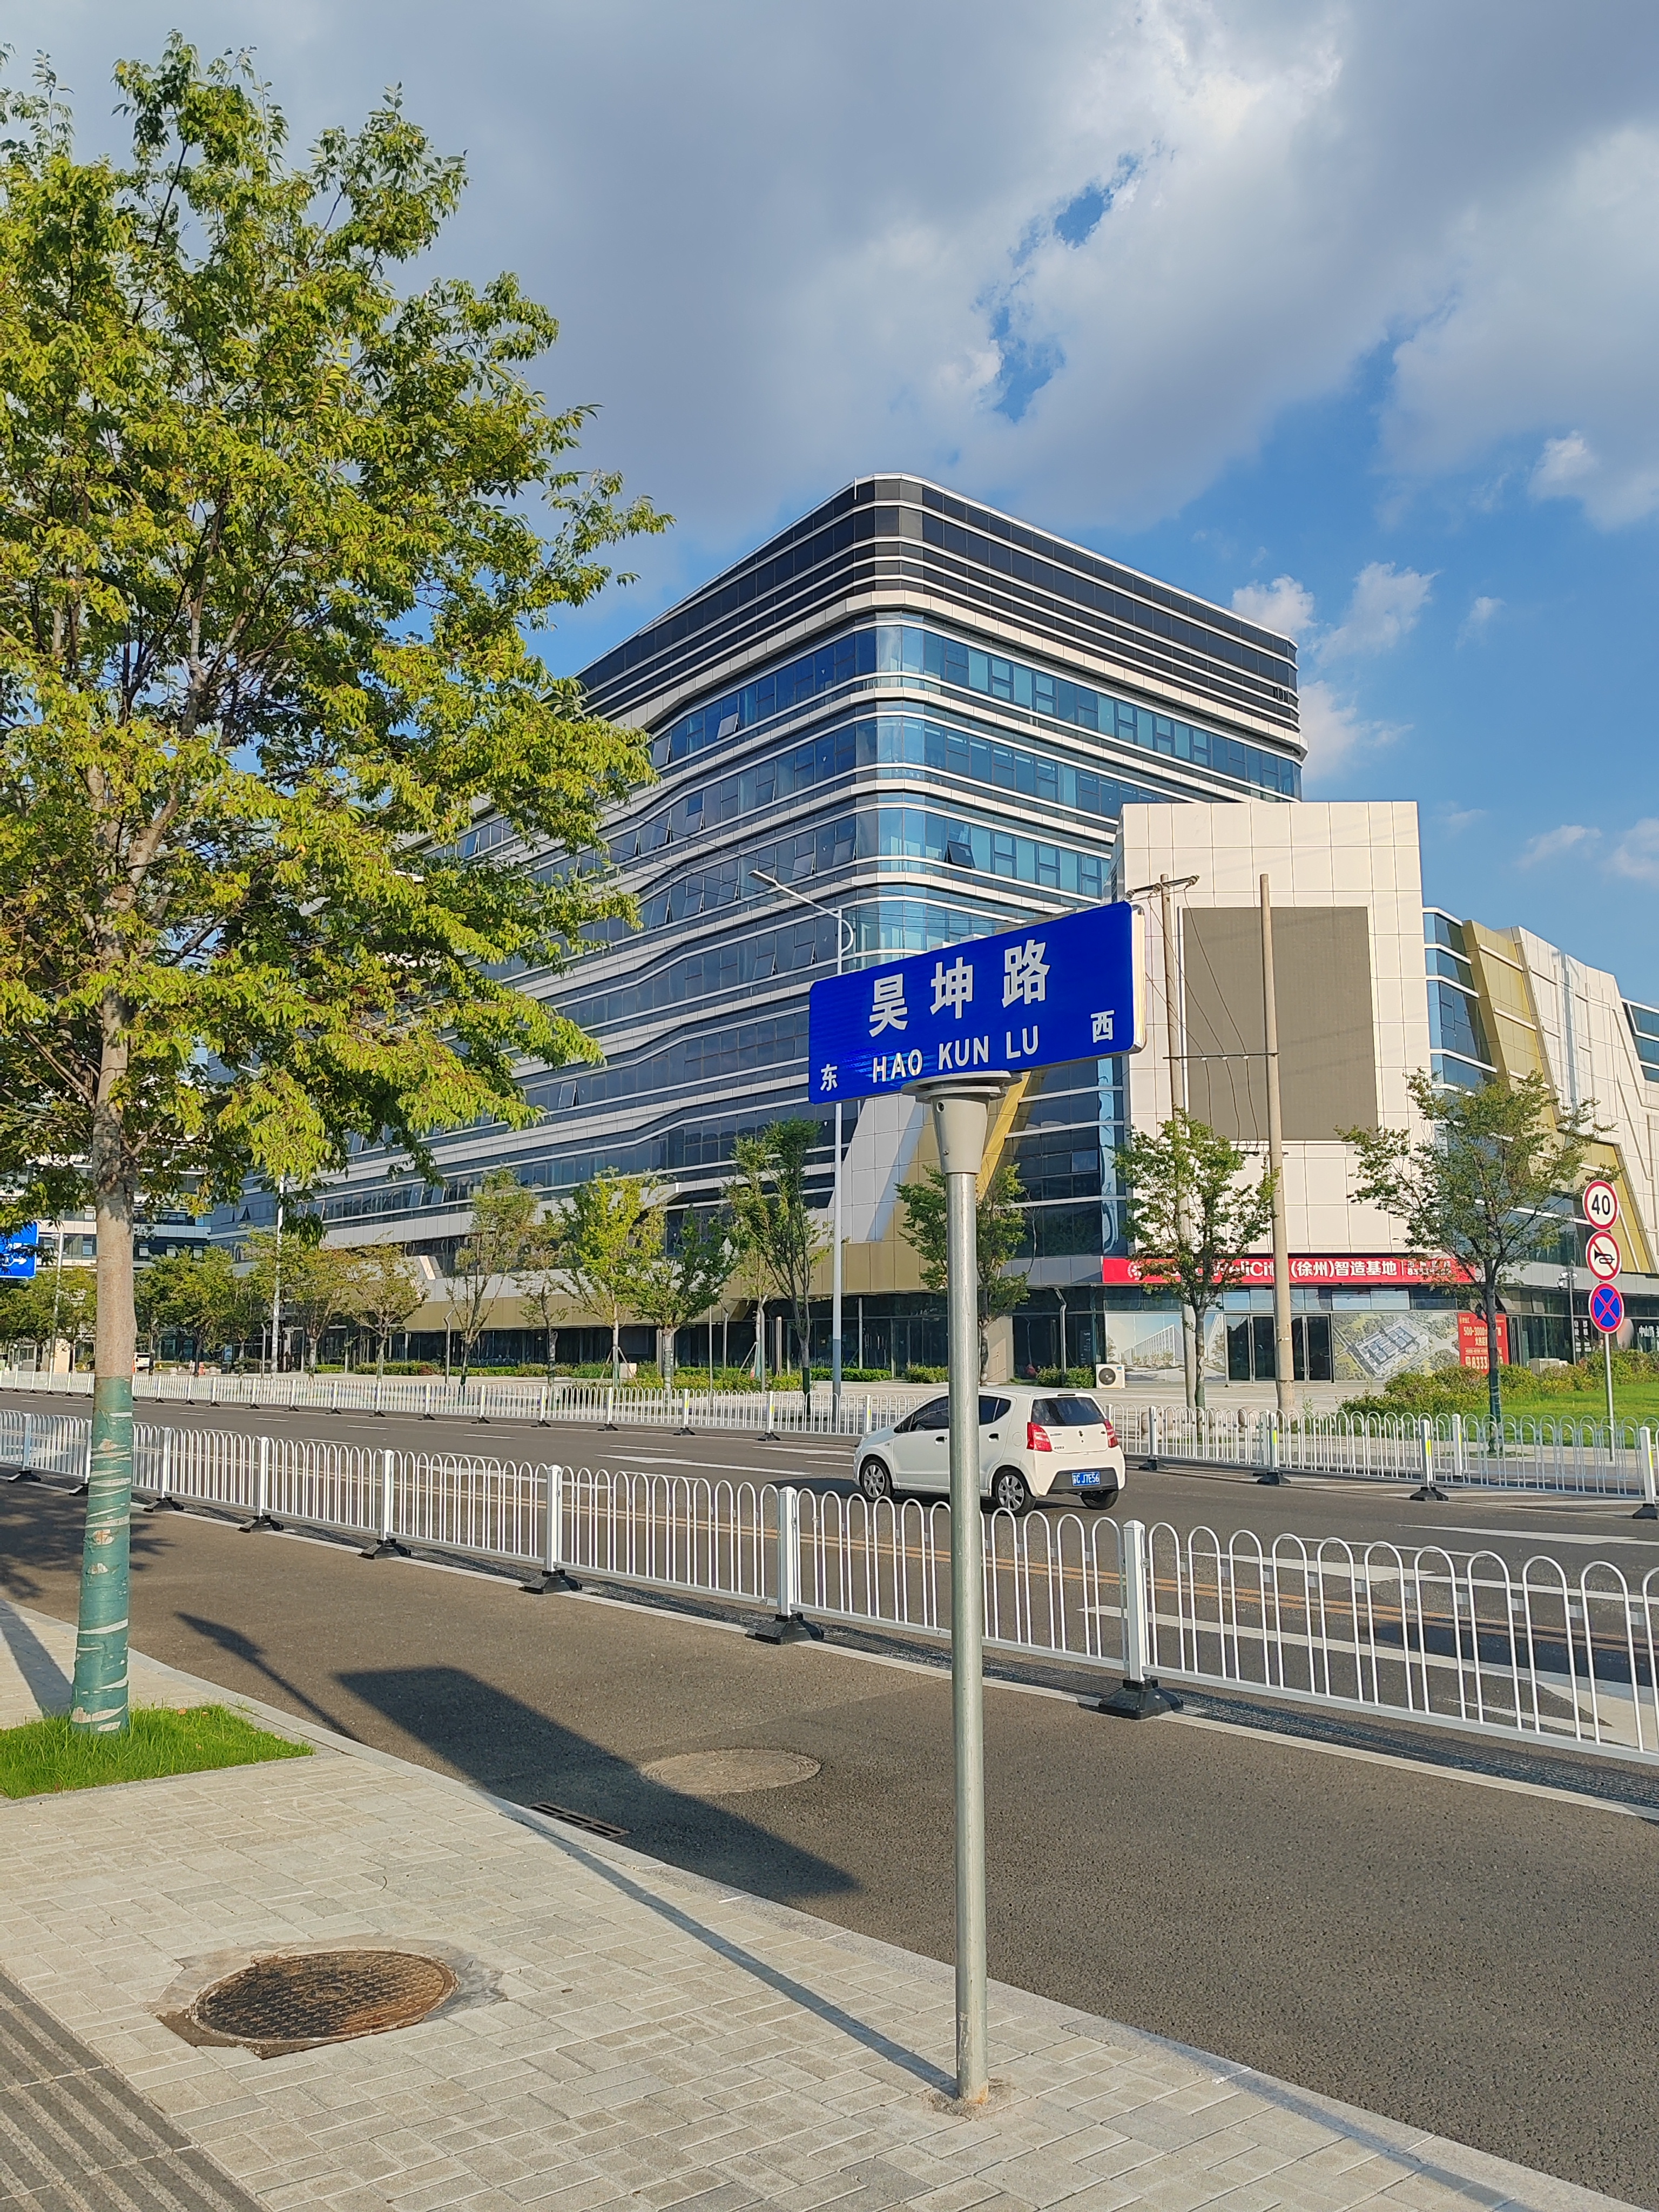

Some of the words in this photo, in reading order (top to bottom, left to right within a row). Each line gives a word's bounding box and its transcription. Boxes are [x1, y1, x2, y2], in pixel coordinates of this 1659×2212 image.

[868, 939, 1051, 1038] 昊坤路
[1090, 1009, 1115, 1043] 西
[872, 1049, 922, 1084] HAO
[939, 1035, 989, 1070] KUN
[1006, 1025, 1038, 1060] LU
[819, 1063, 838, 1092] 东
[1591, 1194, 1610, 1216] 40
